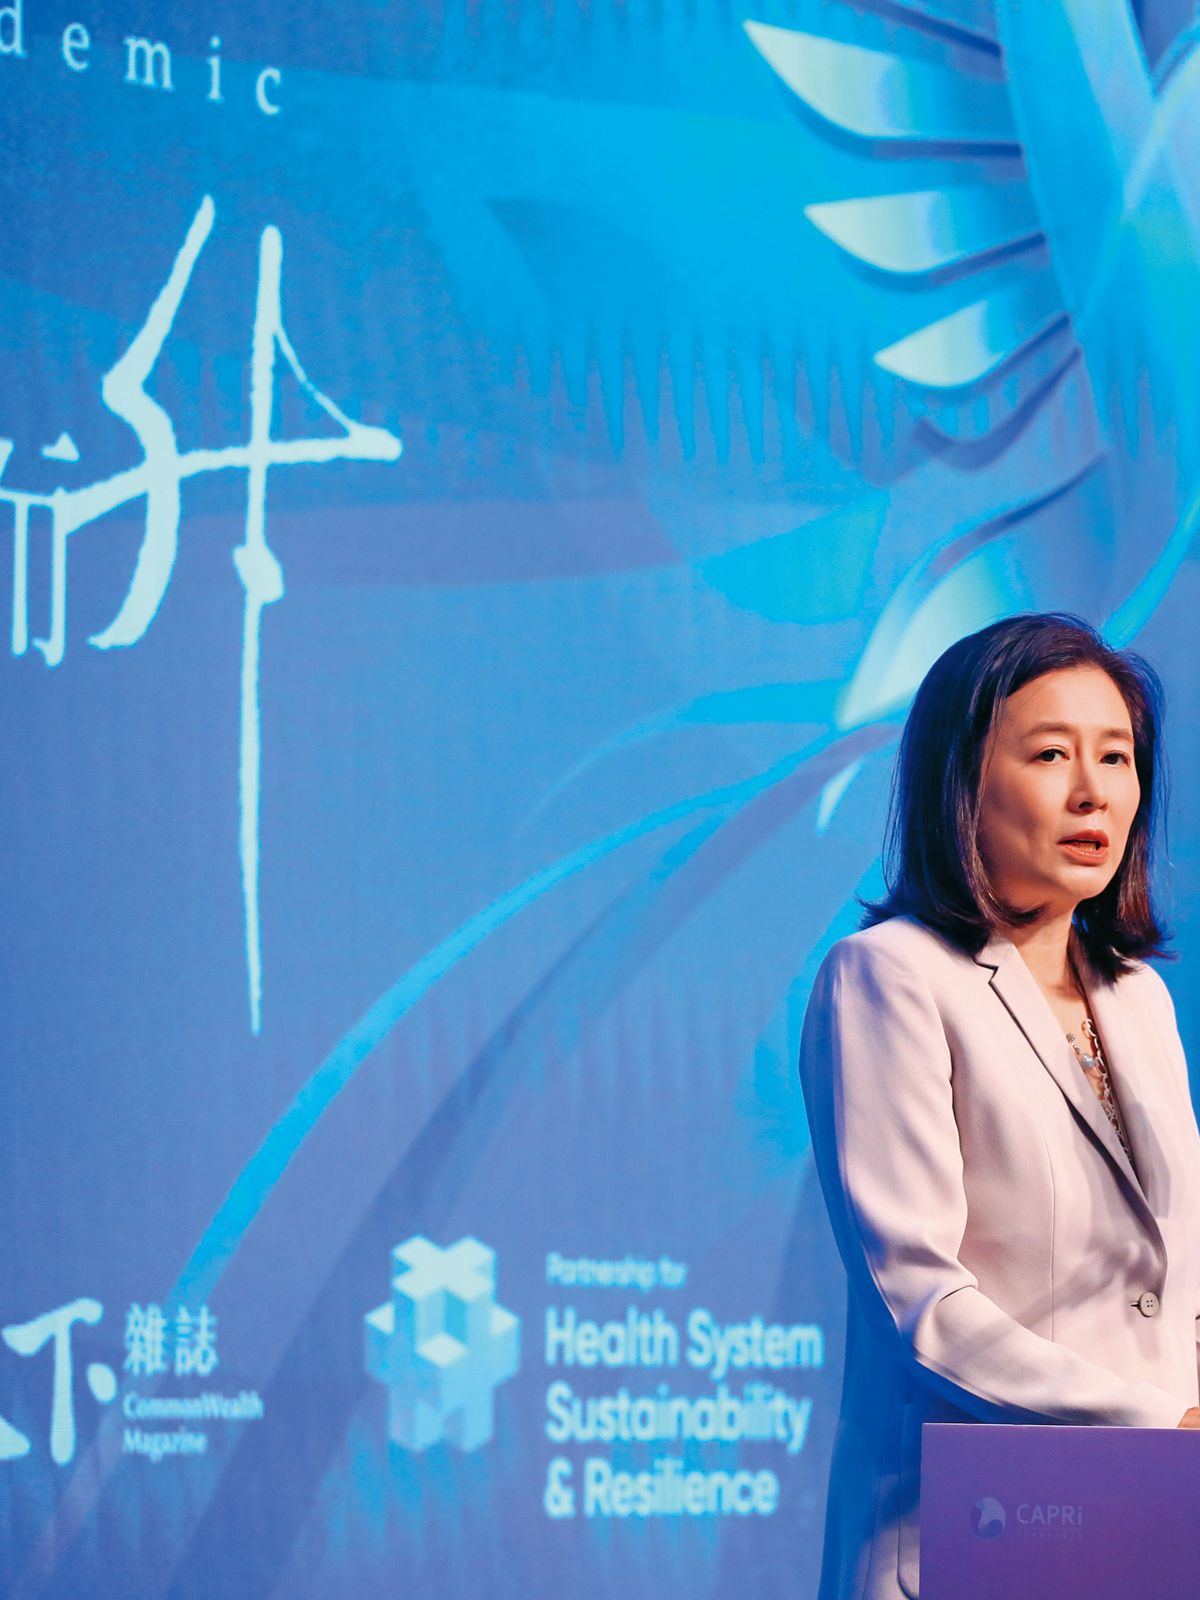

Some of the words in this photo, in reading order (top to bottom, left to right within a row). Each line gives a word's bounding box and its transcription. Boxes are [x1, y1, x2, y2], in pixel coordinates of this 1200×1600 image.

[124, 1302, 218, 1377] 雜誌
[546, 1306, 678, 1367] Health
[686, 1308, 823, 1379] System
[122, 1427, 207, 1461] Magazine
[545, 1382, 812, 1455] Sustainability
[545, 1457, 576, 1518] &
[584, 1456, 780, 1517] Resilience
